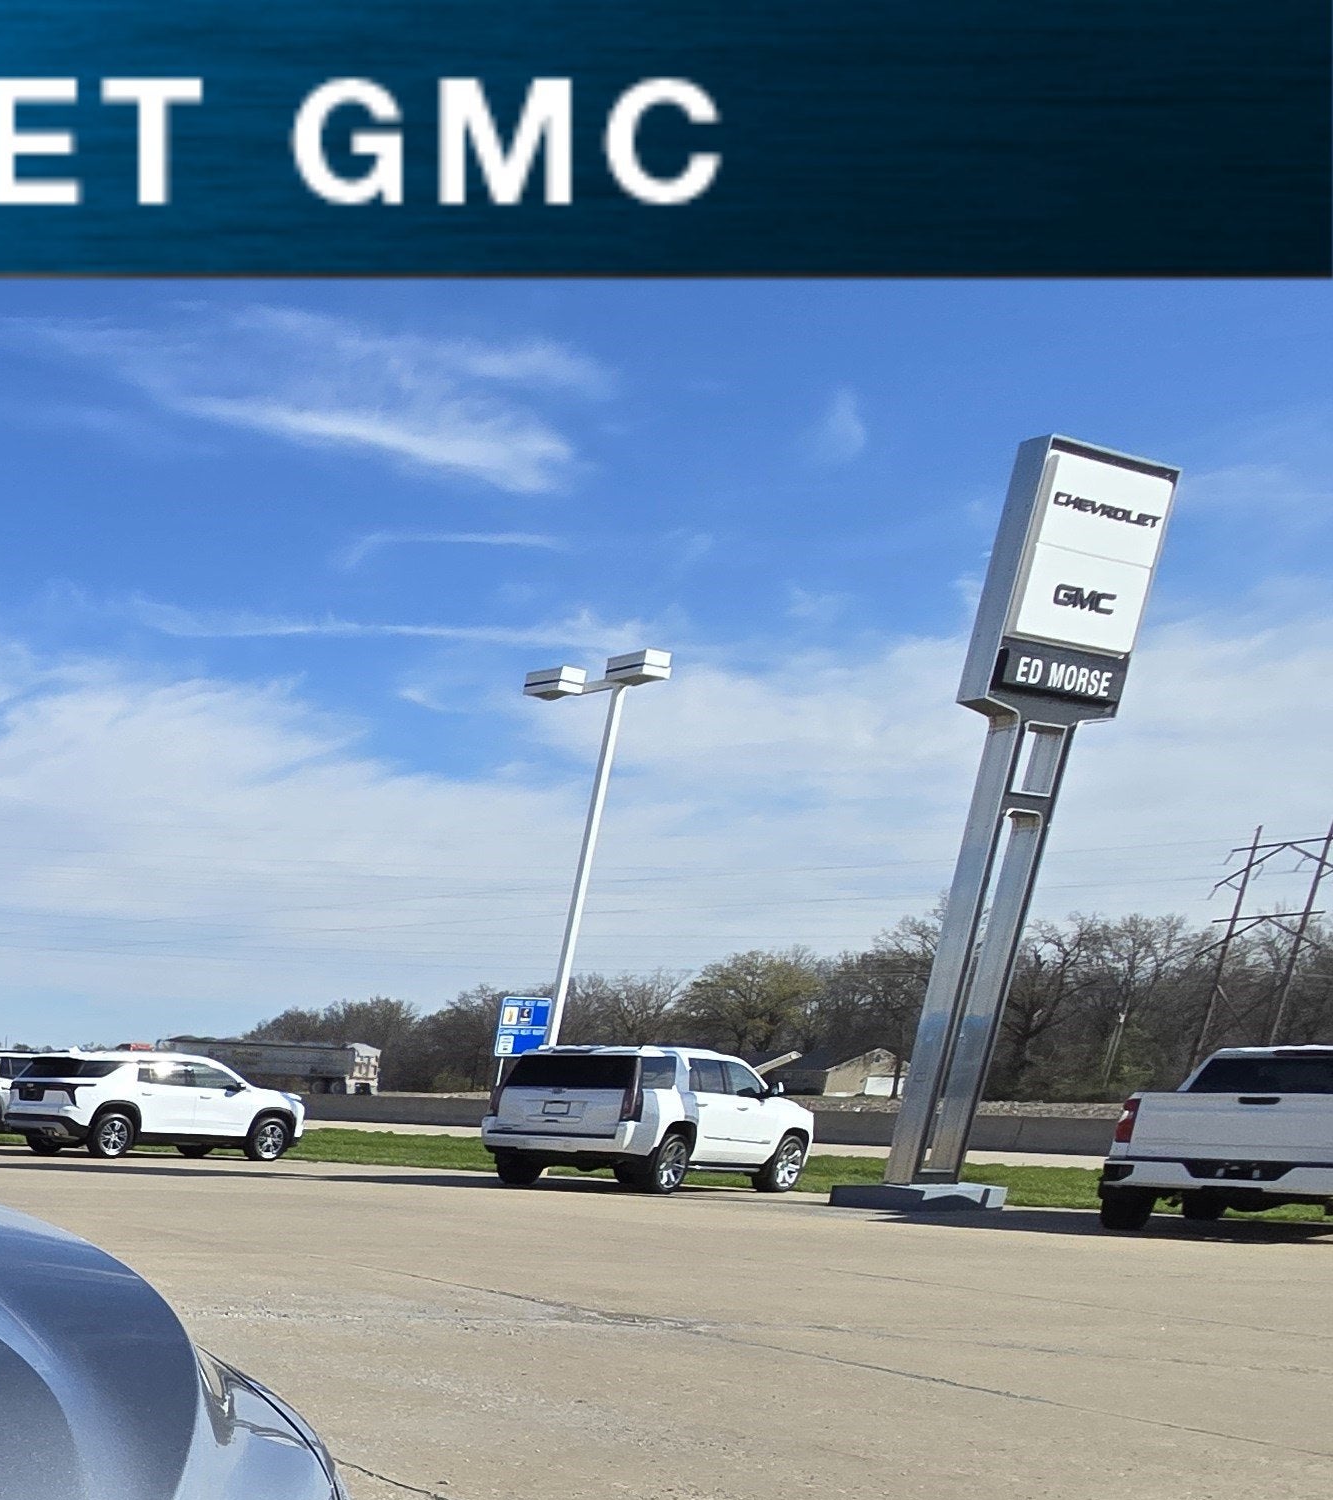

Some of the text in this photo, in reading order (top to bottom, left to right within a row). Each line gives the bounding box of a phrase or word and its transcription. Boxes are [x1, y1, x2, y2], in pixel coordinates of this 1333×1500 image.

[1053, 491, 1162, 528] CHEVROLET
[1053, 583, 1117, 616] GMC
[1015, 656, 1113, 697] ED MORSE
